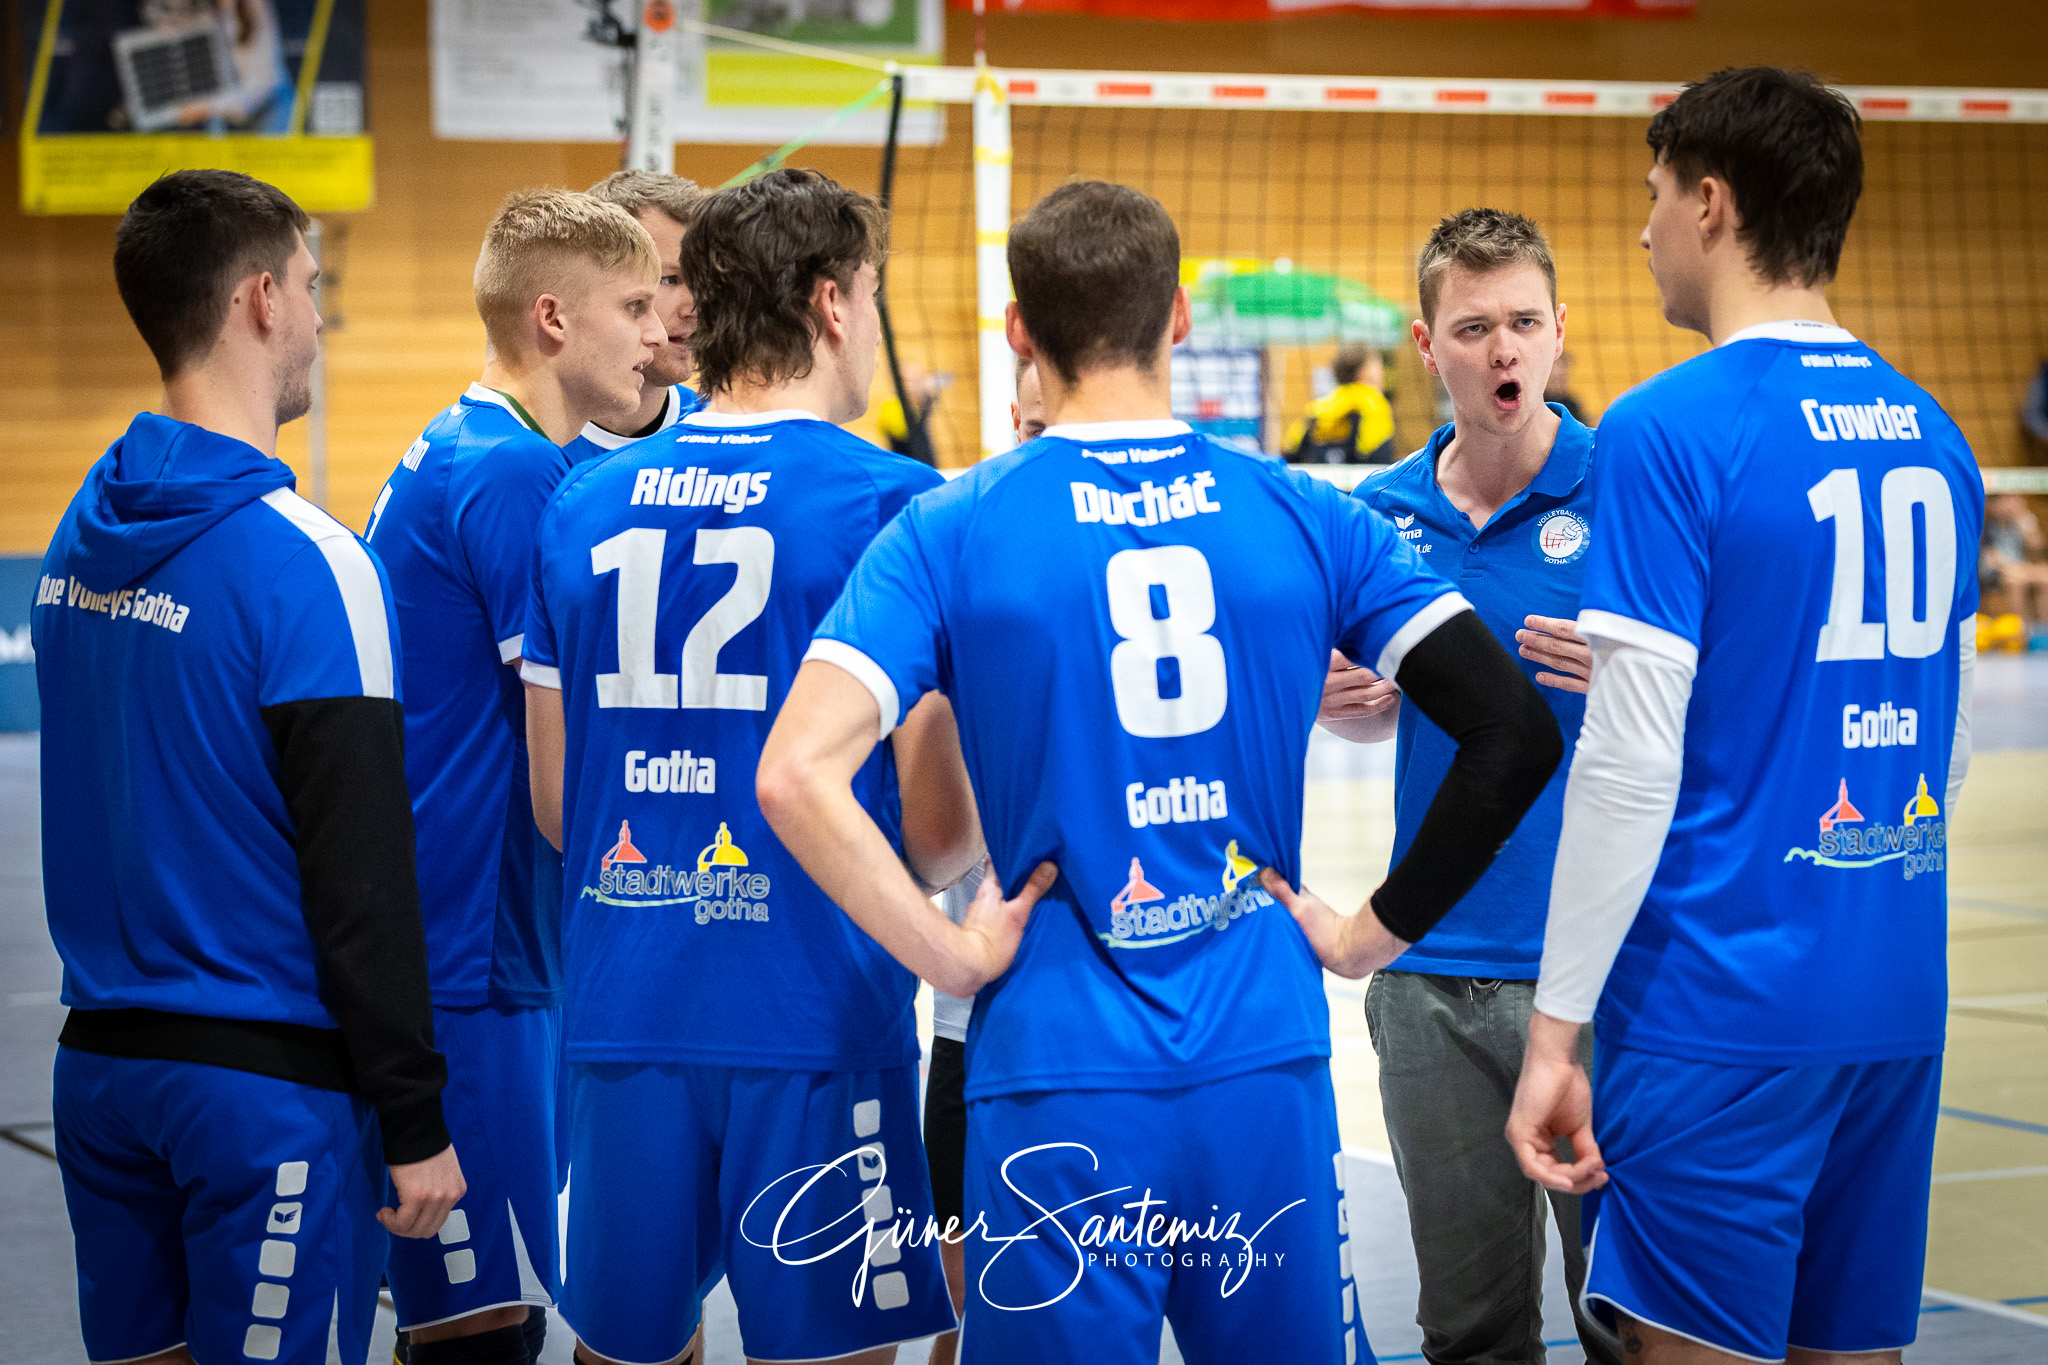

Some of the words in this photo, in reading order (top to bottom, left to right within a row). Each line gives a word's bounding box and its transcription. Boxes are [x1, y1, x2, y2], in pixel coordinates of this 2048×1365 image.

[1800, 397, 1921, 441] Crowder
[630, 467, 772, 514] Ridings
[1070, 471, 1221, 527] Ducháč
[1537, 509, 1576, 527] VOLLEYBALL
[1544, 556, 1568, 565] GOTHA
[1807, 466, 1957, 662] 10
[131, 588, 190, 633] Gotha
[591, 526, 775, 711] 12
[1106, 545, 1228, 738] 8
[1842, 701, 1918, 749] Gotha
[625, 750, 716, 793] Gotha
[1125, 776, 1229, 829] Gotha
[1818, 818, 1946, 857] stadtwerke
[600, 864, 771, 900] stadtwerke
[694, 898, 770, 925] gotha
